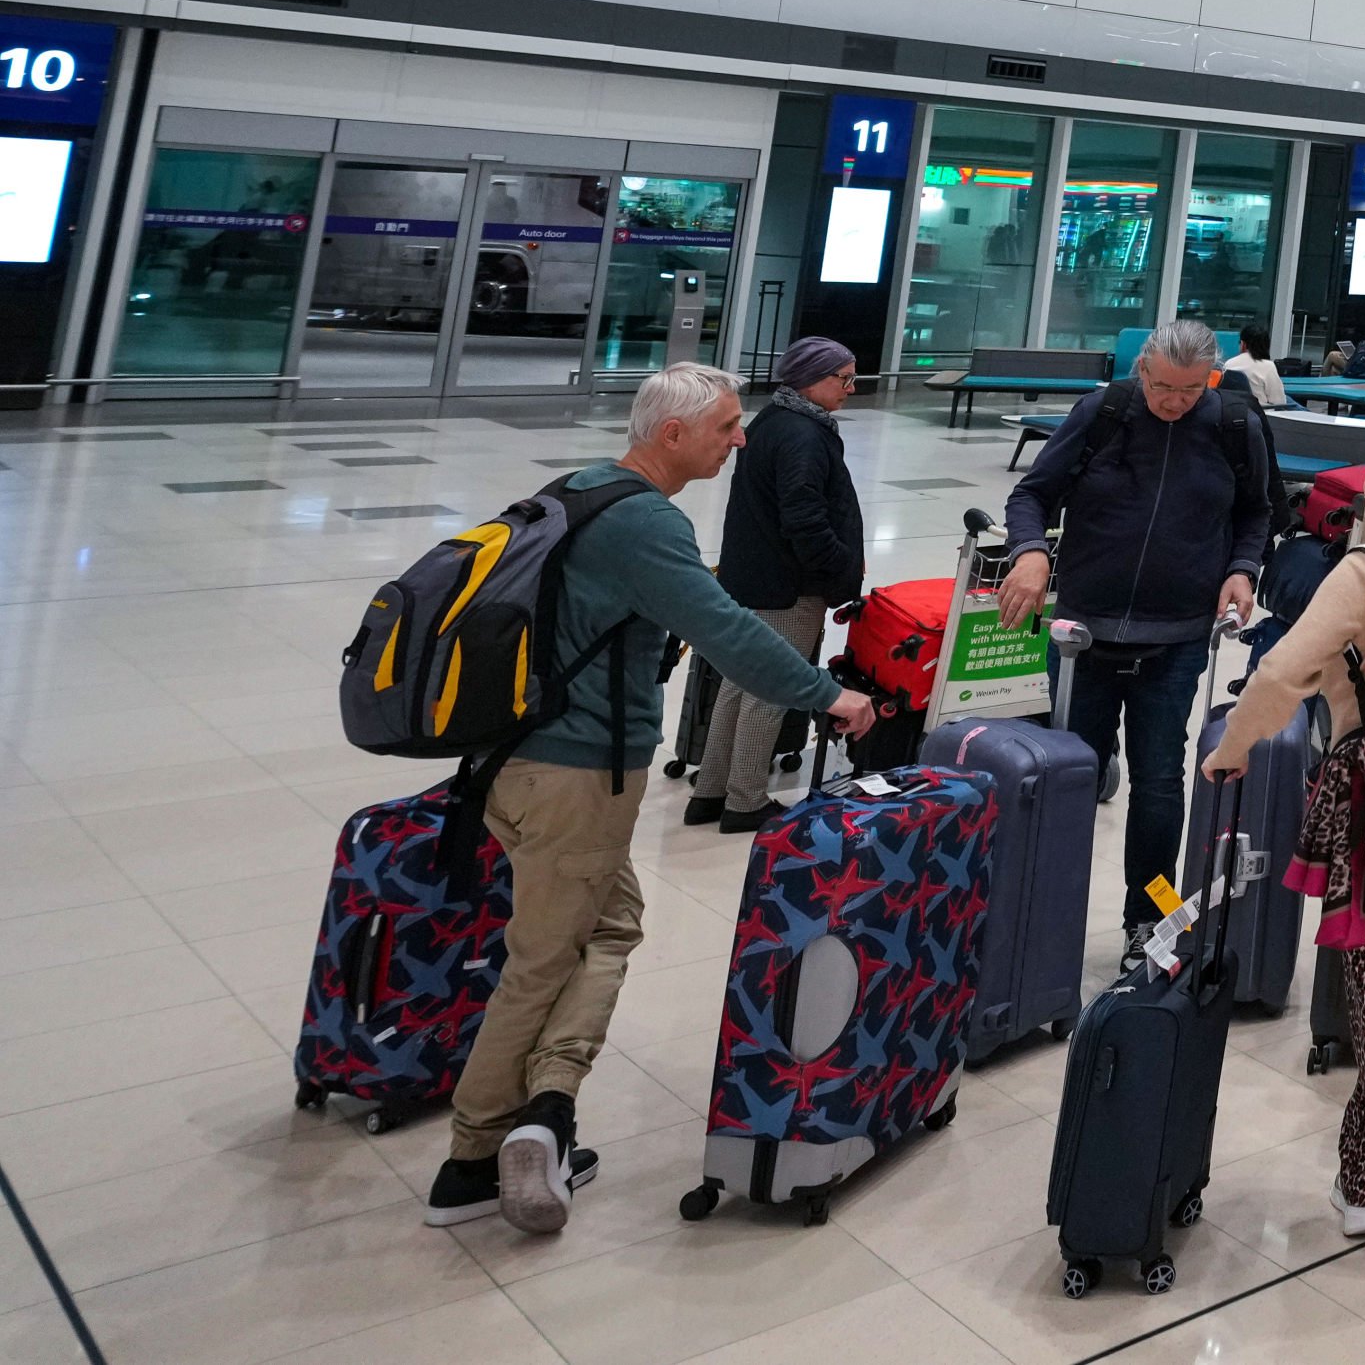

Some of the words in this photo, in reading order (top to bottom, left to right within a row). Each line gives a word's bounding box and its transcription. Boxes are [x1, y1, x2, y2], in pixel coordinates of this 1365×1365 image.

[0, 47, 75, 92] 10
[853, 119, 889, 154] 11
[519, 229, 543, 238] Auto
[544, 230, 567, 239] door
[973, 624, 994, 633] Easy
[971, 634, 990, 645] with
[992, 632, 1021, 642] Weixin
[968, 643, 1025, 659] 有朋自遠方來
[976, 688, 999, 698] Weixin
[1000, 687, 1012, 695] Pay
